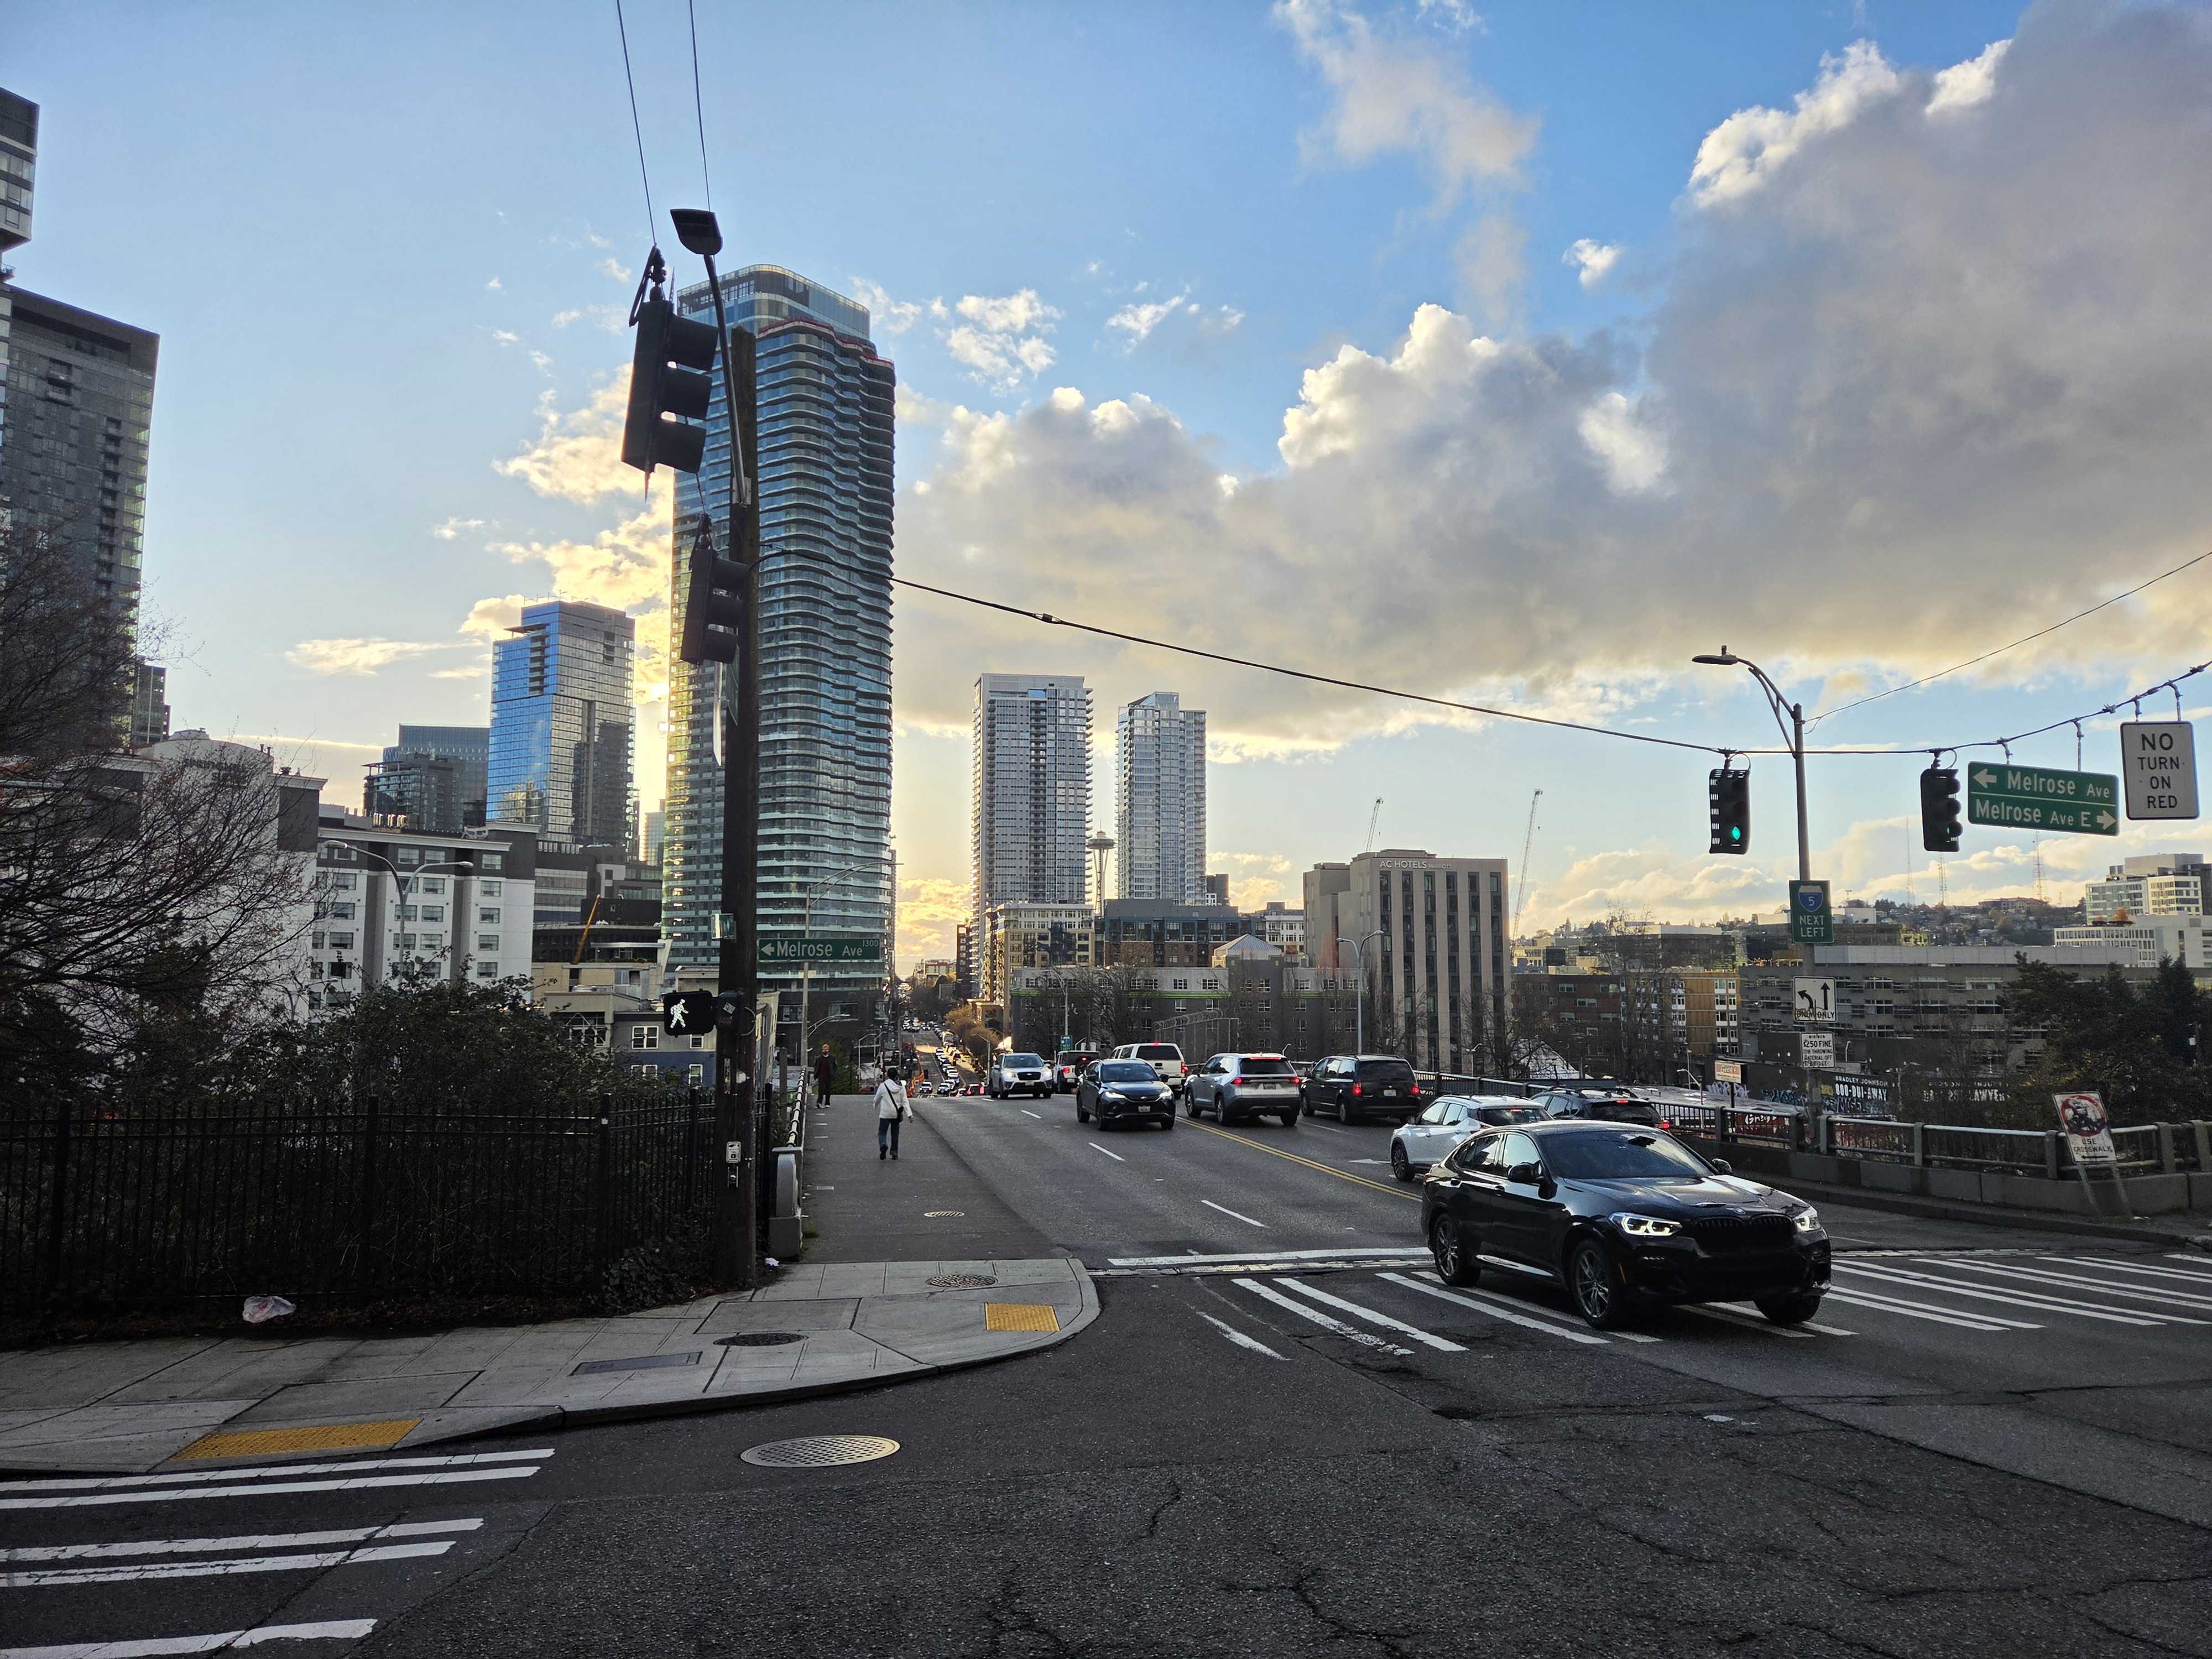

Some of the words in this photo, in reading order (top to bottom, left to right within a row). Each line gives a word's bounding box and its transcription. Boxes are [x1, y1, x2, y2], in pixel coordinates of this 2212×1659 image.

[2141, 733, 2173, 750] NO
[2137, 757, 2179, 770] TURN
[2007, 770, 2075, 795] Melrose
[2086, 783, 2110, 798] Ave
[2150, 776, 2171, 789] ON
[2147, 795, 2177, 808] RED
[1976, 799, 2042, 823] Melrose
[2050, 811, 2074, 826] Ave
[2081, 811, 2091, 827] E
[1809, 896, 1814, 906] 5
[1799, 915, 1825, 925] NEXT
[1801, 927, 1825, 937] LEFT
[777, 941, 833, 957] Melrose
[842, 946, 863, 956] Ave
[1861, 1078, 1889, 1087] JOHNSON
